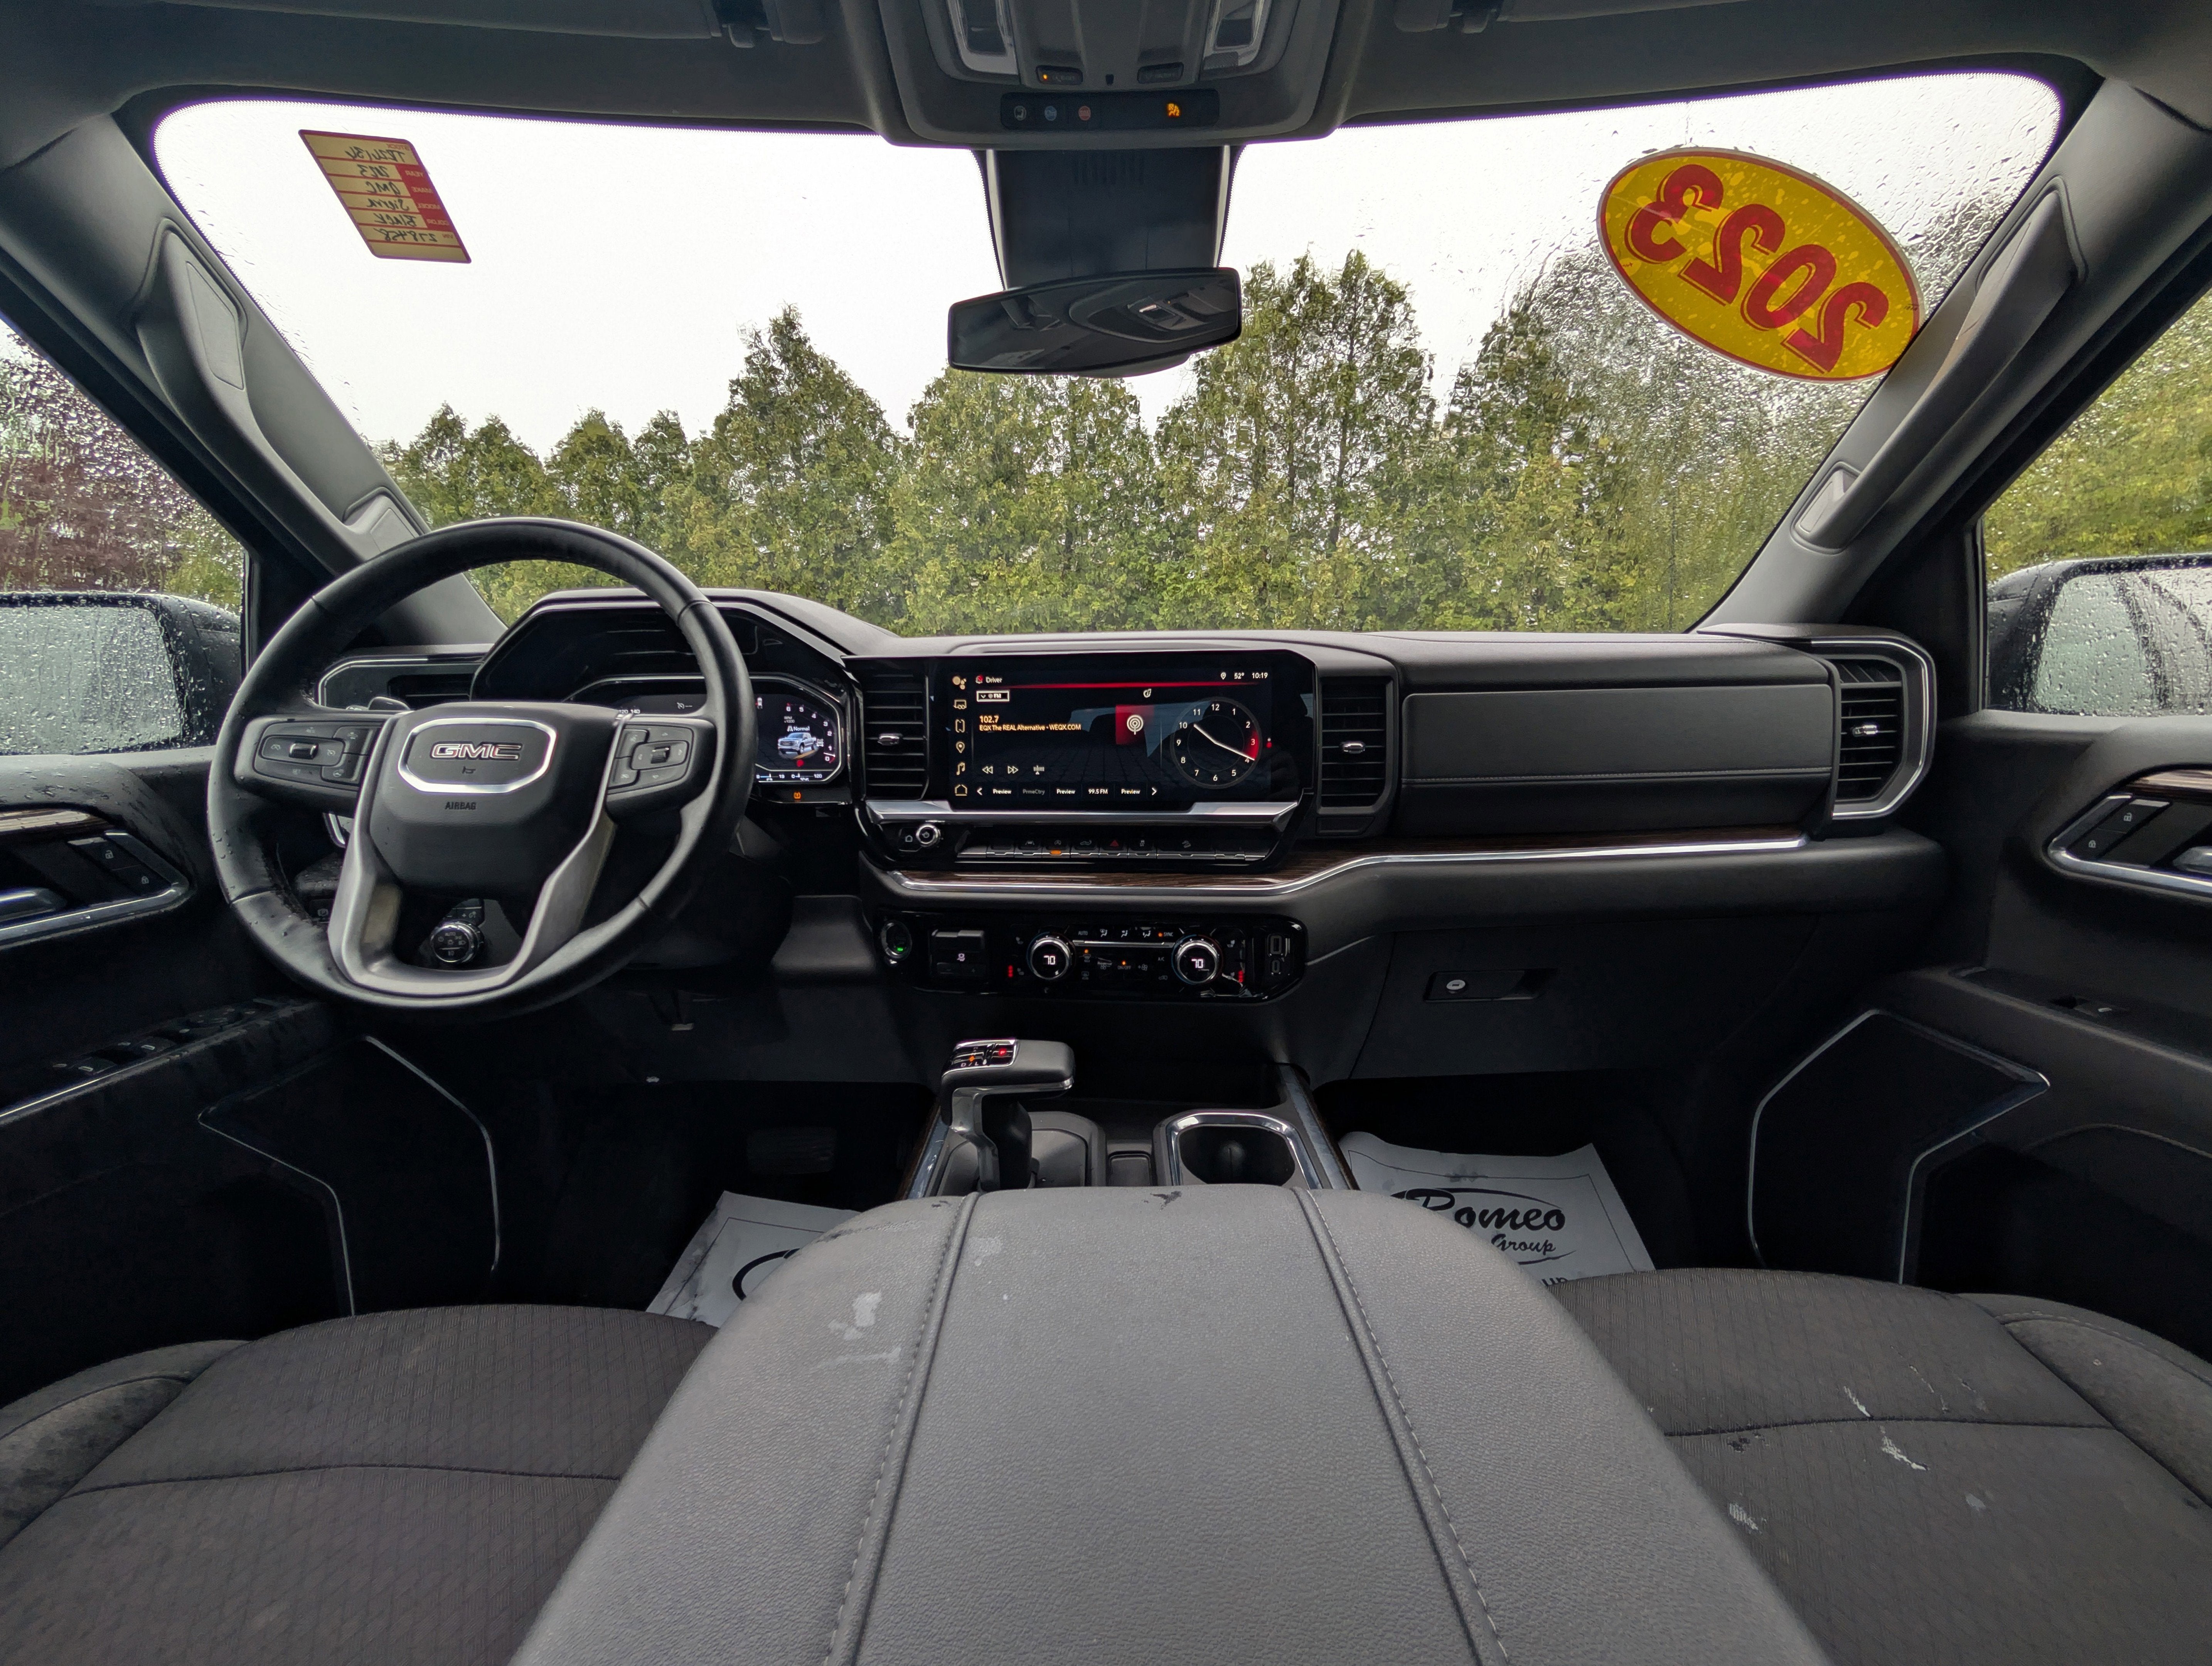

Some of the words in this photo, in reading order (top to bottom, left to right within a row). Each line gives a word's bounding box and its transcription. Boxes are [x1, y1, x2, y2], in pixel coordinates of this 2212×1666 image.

[430, 741, 522, 761] GMC
[445, 801, 477, 810] AIRBAG
[1044, 955, 1056, 965] 70
[1191, 958, 1203, 968] 70
[1491, 1233, 1556, 1255] Group
